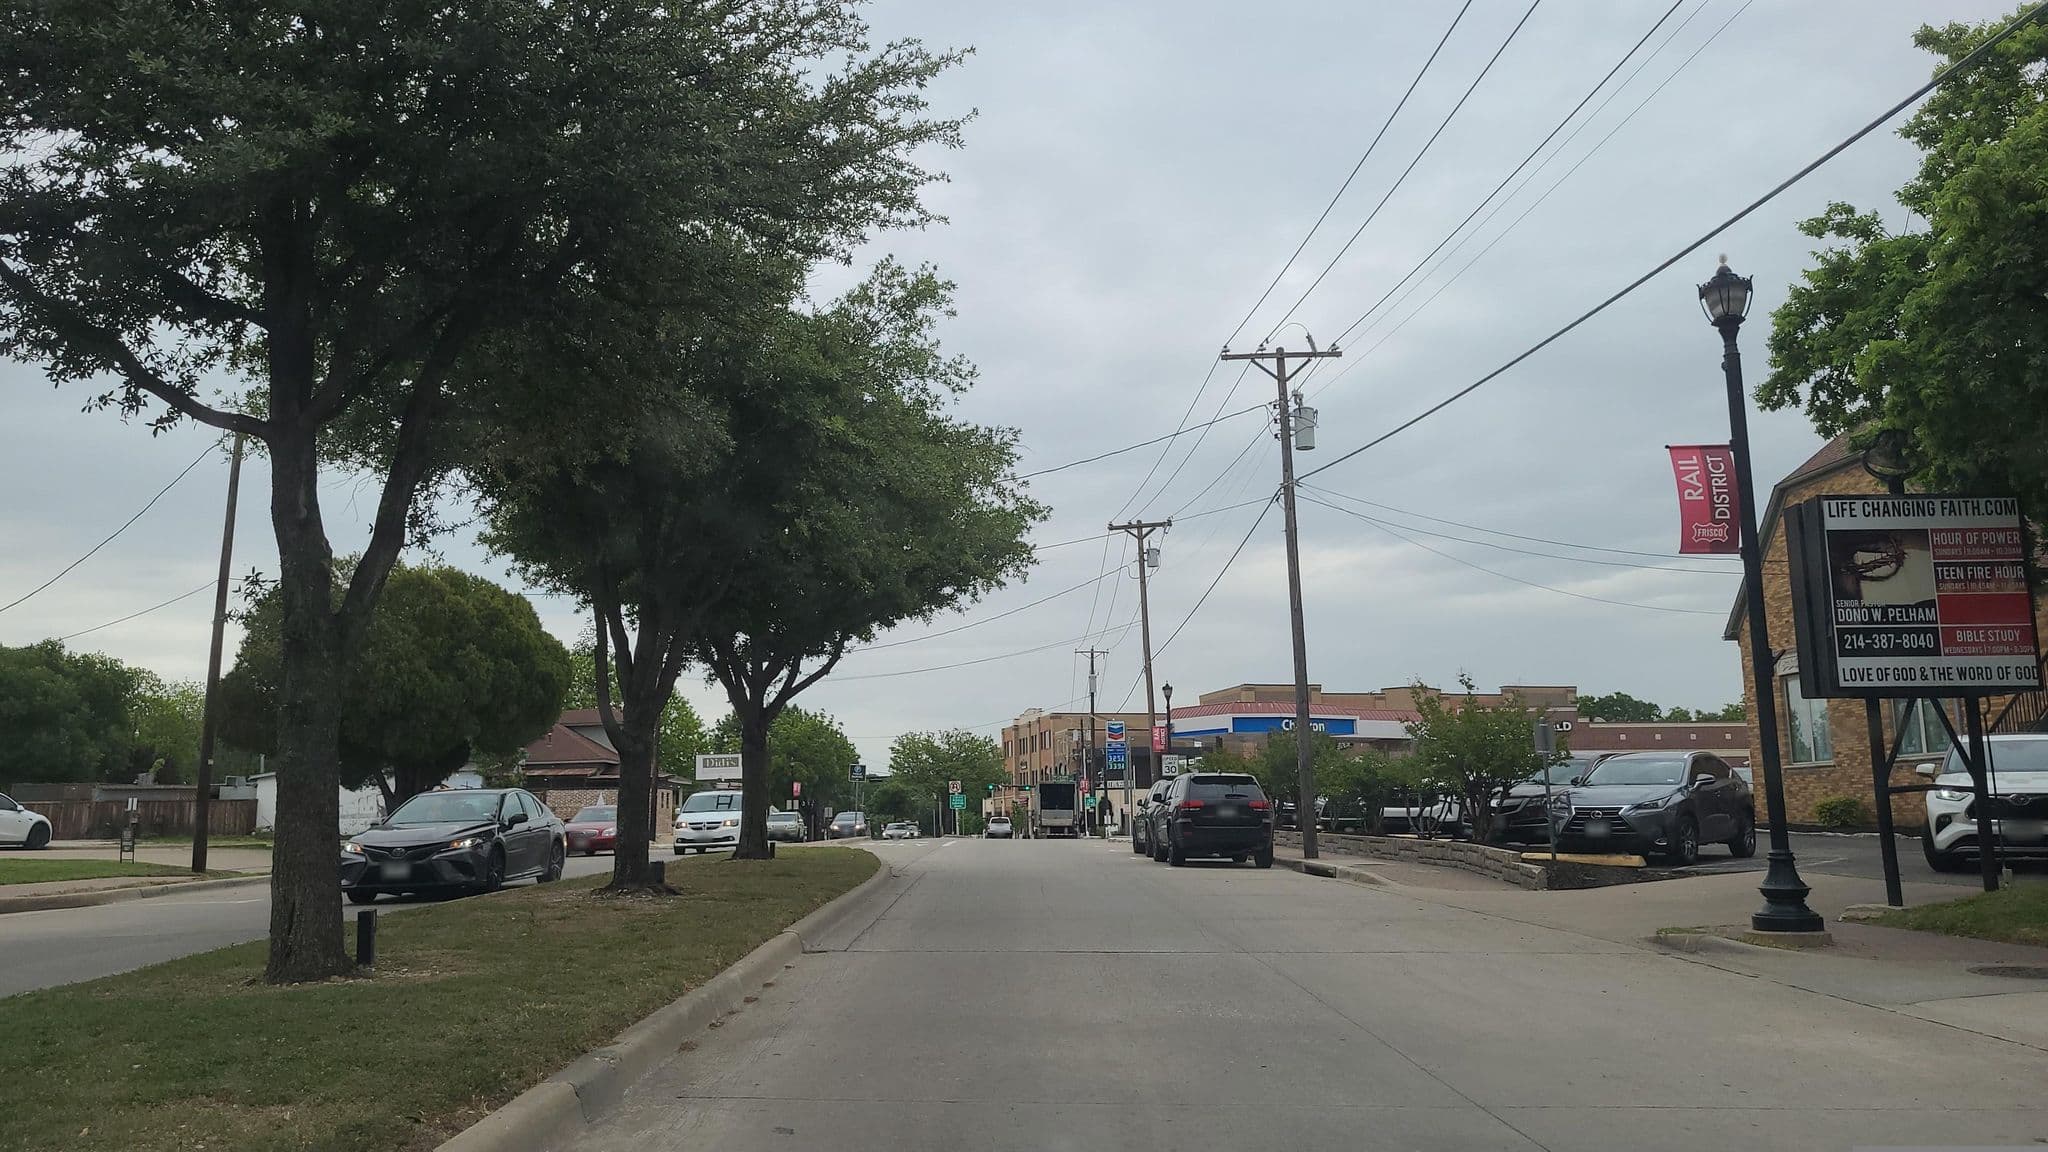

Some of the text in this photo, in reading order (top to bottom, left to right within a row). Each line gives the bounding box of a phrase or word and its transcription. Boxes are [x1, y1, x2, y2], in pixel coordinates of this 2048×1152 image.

[1678, 455, 1705, 500] RAIL
[1706, 455, 1731, 519] DISTRICT
[1828, 499, 2017, 518] LIFE CHANGING FAITH.COM
[1697, 528, 1723, 537] FRISCO
[1933, 531, 2020, 545] HOUR OF POWER
[1936, 566, 2024, 580] TEEN FIRE HOUR
[1835, 600, 1859, 608] SENIOR
[1837, 608, 1936, 622] DONO W. PELHAM
[1843, 633, 1934, 649] 214-387-8040
[1956, 629, 2020, 642] BIBLE STUDY
[1944, 646, 1983, 654] WEDNESDAYS
[1842, 665, 2039, 682] LOVE OF GOD & THE WORD OF GOD
[1164, 765, 1177, 774] 30
